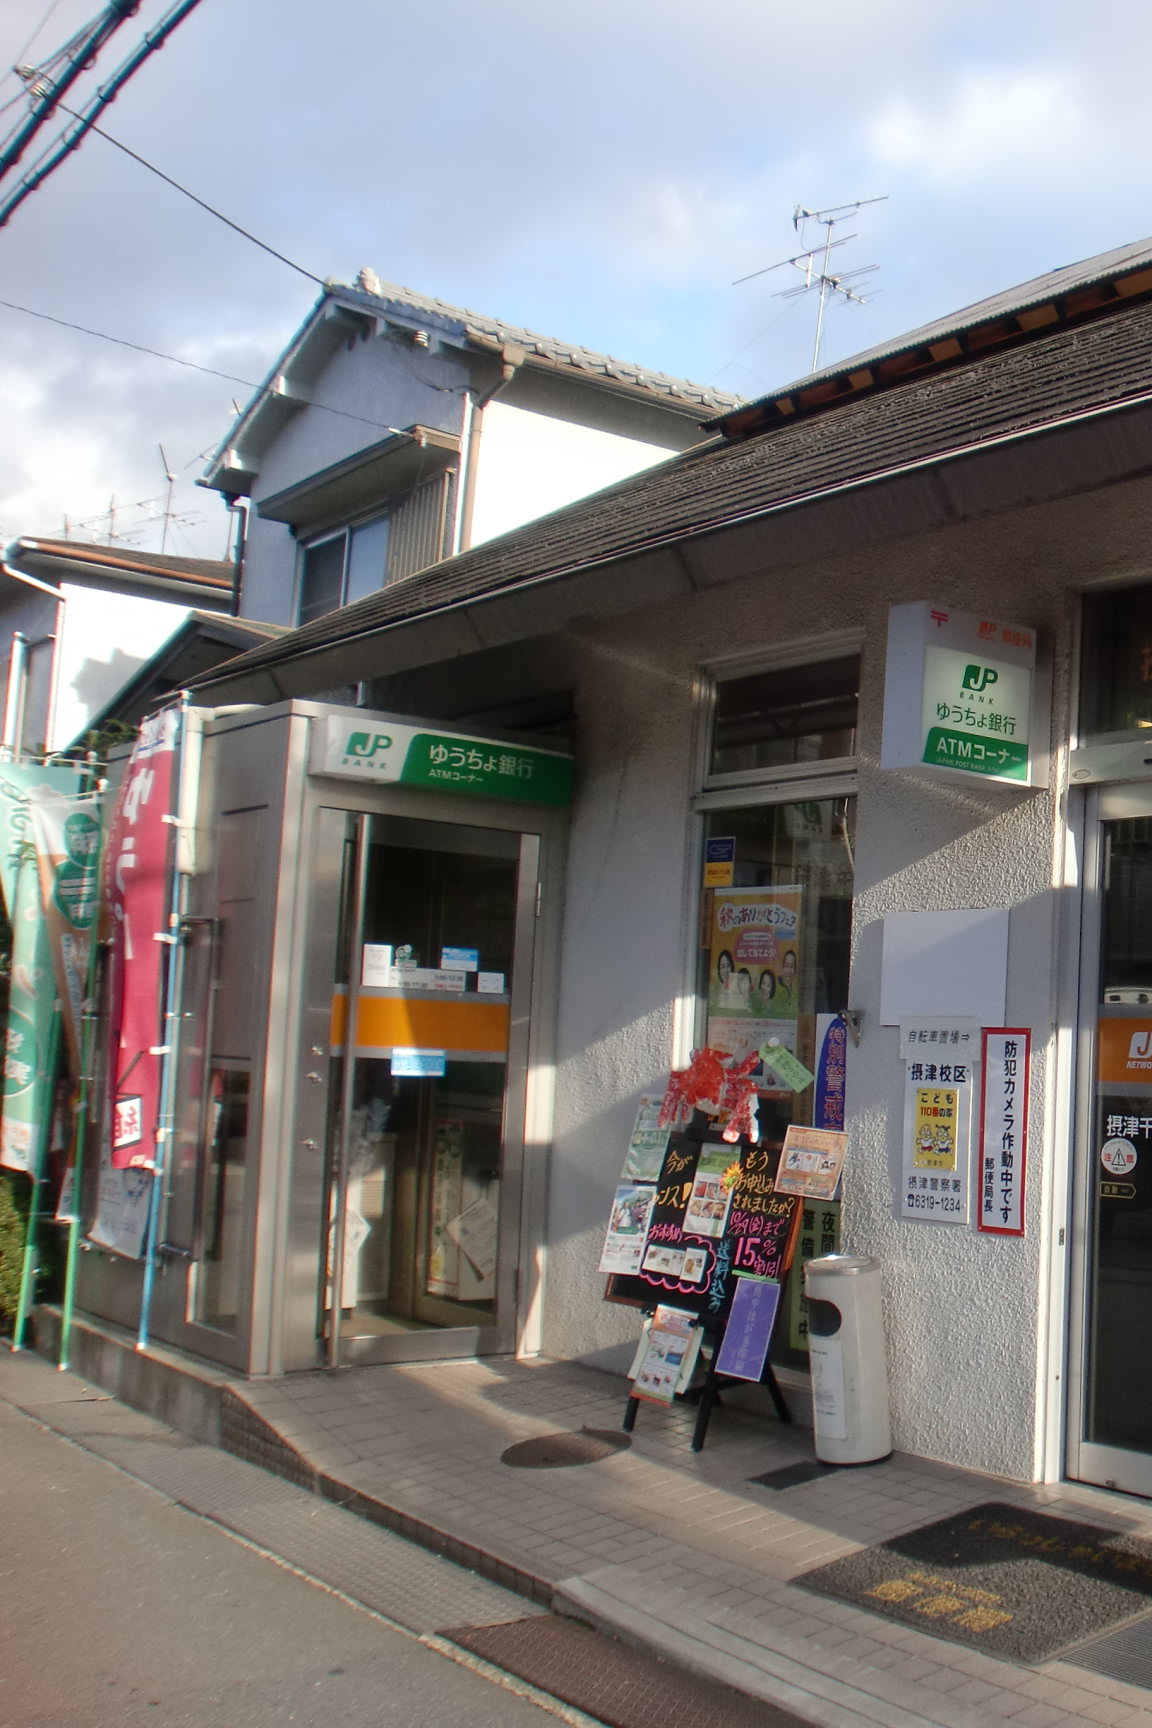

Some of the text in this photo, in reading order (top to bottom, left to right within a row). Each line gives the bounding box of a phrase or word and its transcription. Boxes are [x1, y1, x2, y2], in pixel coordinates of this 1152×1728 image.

[962, 664, 998, 692] JP
[960, 691, 994, 705] BANK
[937, 702, 1016, 735] ゆうちょ銀行
[345, 731, 392, 757] JP
[936, 736, 1021, 764] ATMコーナー
[341, 757, 386, 769] BANK
[429, 743, 534, 779] ゆうちょ銀行
[428, 768, 485, 782] ATMコーナー
[911, 1063, 967, 1083] 摂津校区
[920, 1092, 954, 1105] こども
[920, 1106, 954, 1118] 110番の家
[1000, 1040, 1018, 1224] 防犯カメラ作動中です
[667, 1151, 693, 1174] 今が
[746, 1151, 769, 1171] もう
[908, 1175, 961, 1193] 摂津警察署
[984, 1157, 995, 1213] 郵便局長
[915, 1194, 961, 1212] 6319-1234
[821, 1210, 835, 1255] 夜間
